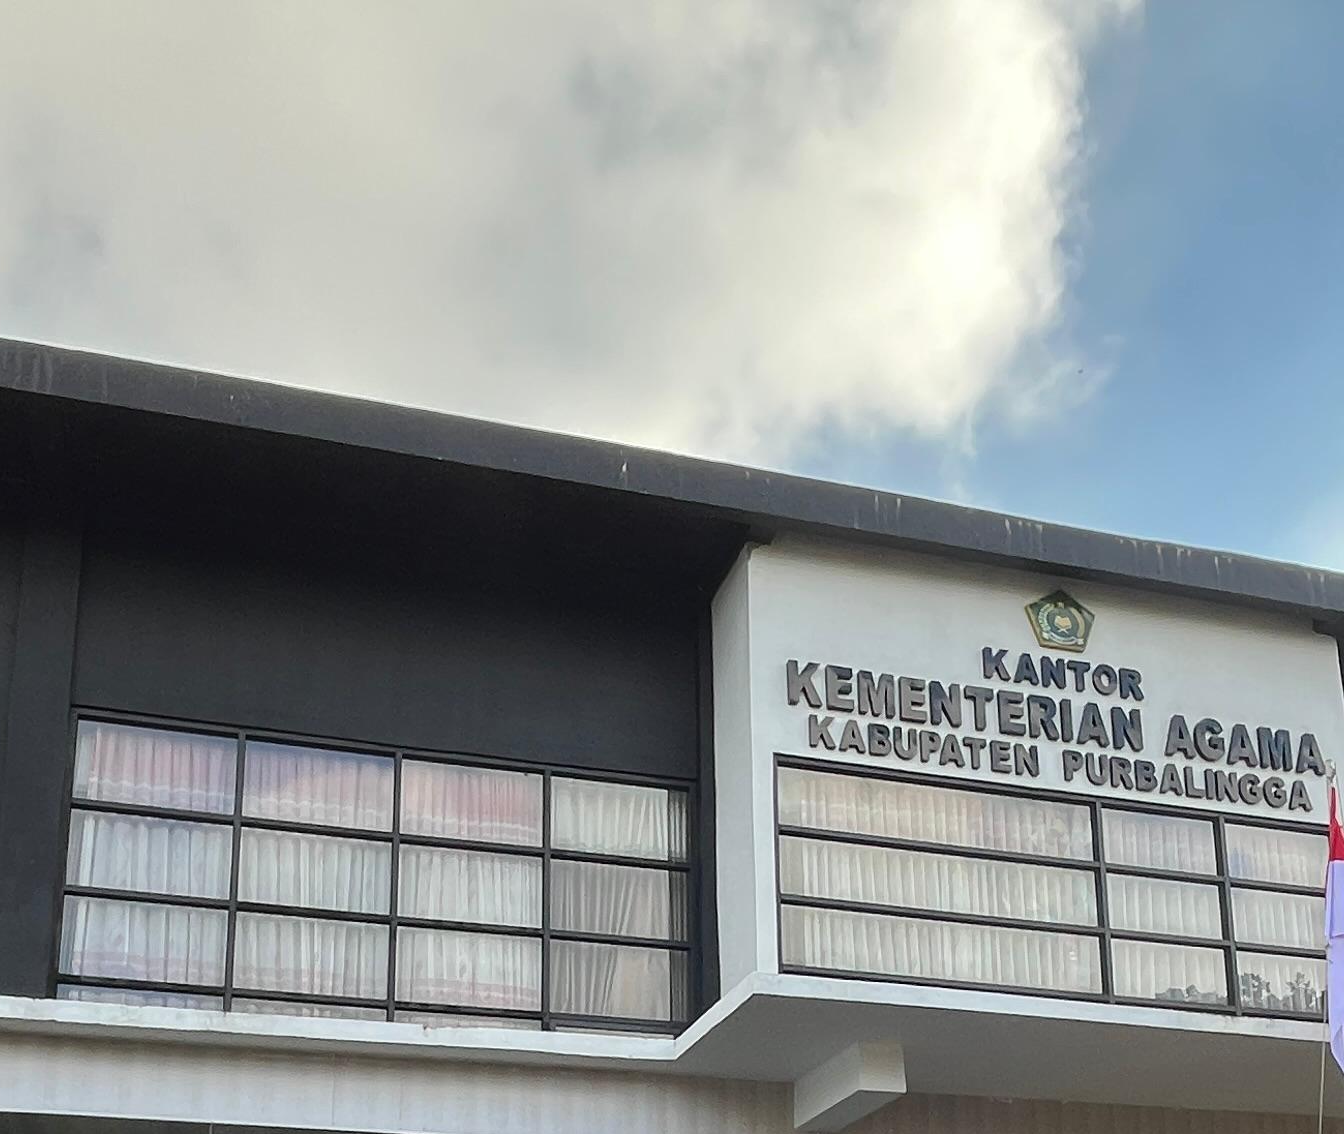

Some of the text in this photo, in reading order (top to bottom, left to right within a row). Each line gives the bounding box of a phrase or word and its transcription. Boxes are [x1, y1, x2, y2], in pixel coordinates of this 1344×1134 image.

[785, 659, 1327, 776] KEMENTERIAN AGAMA
[981, 647, 1144, 700] KANTOR
[807, 714, 1314, 812] KABUPATEN PURBALINGGA
